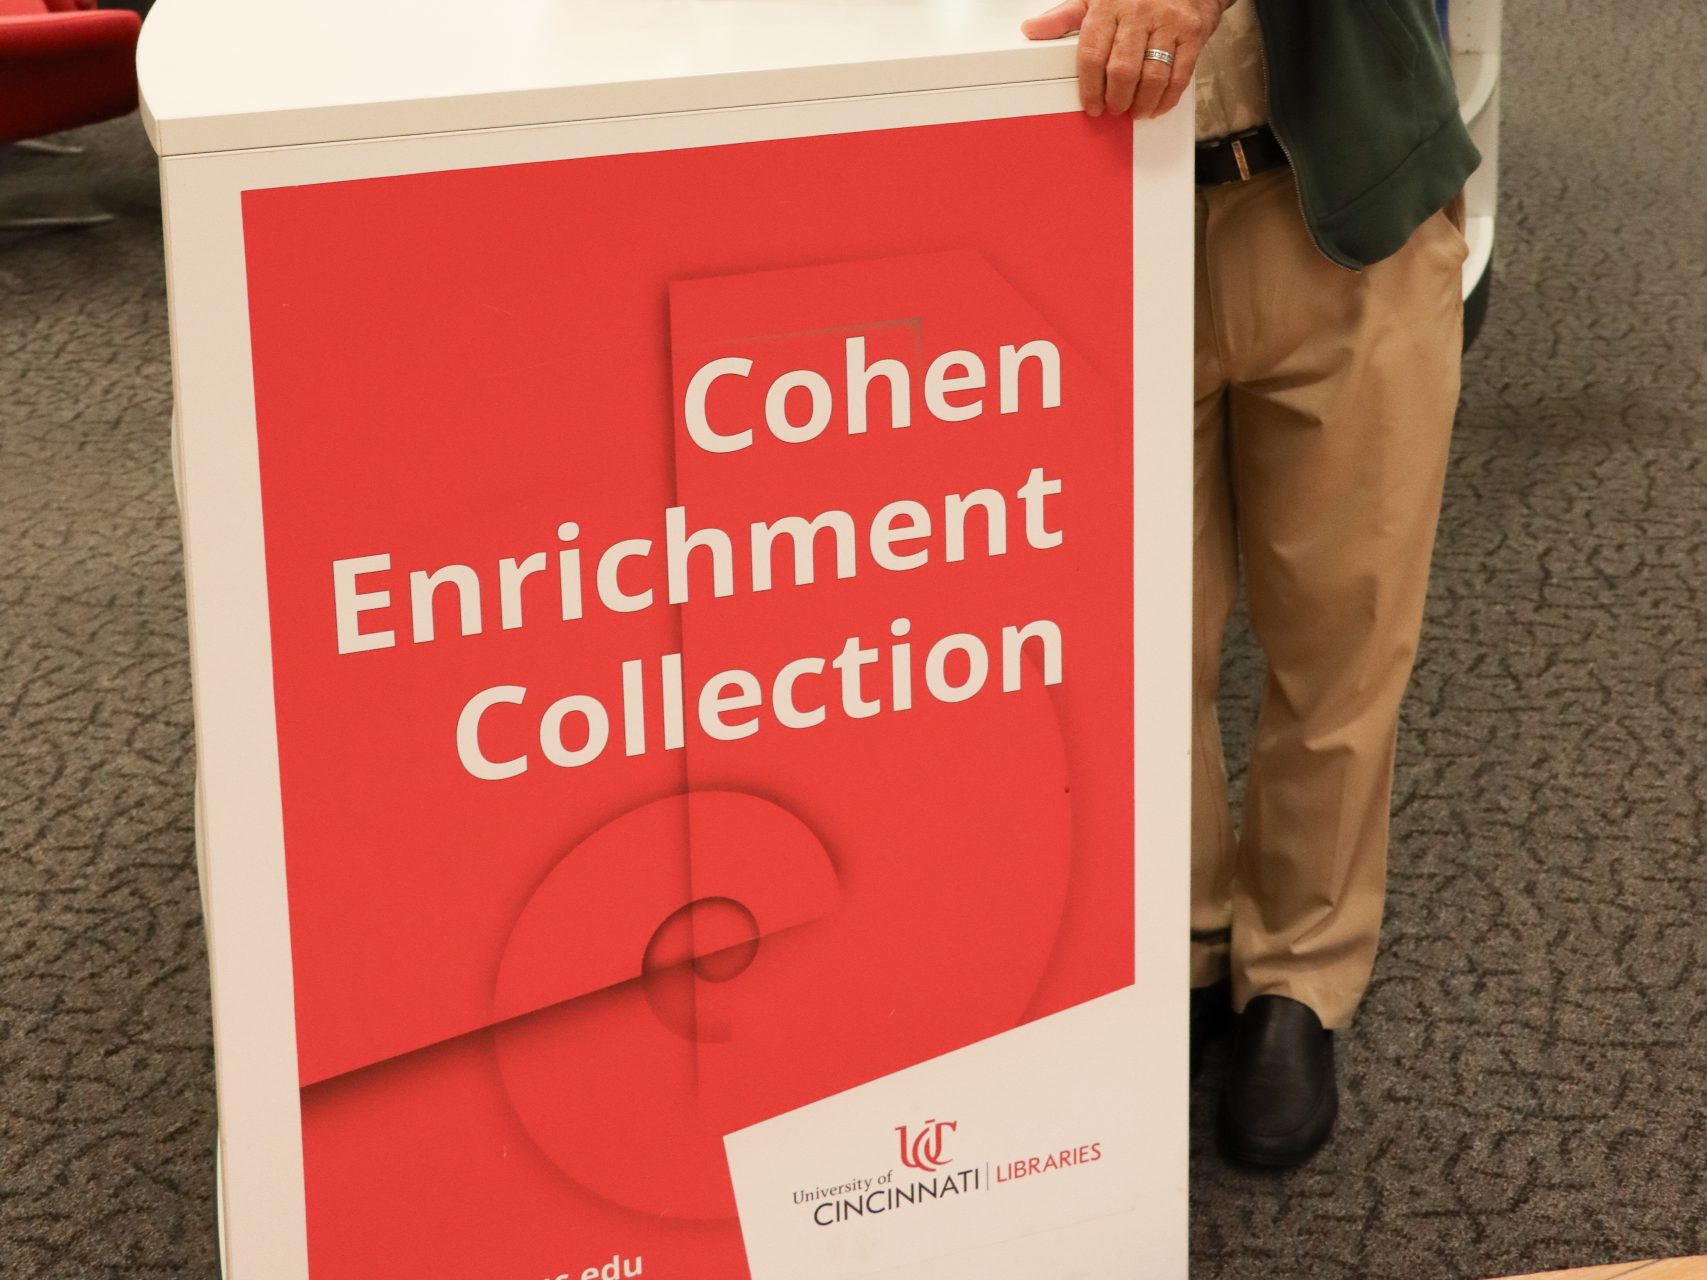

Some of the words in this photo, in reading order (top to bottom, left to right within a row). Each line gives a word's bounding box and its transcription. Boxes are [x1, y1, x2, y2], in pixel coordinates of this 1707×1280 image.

[684, 336, 1062, 453] Cohen
[332, 467, 1063, 655] Enrichment
[456, 618, 1063, 781] Collection
[793, 1176, 872, 1205] University
[877, 1170, 894, 1185] of
[813, 1168, 979, 1226] CINCINNATI
[996, 1142, 1102, 1183] LIBRARIES
